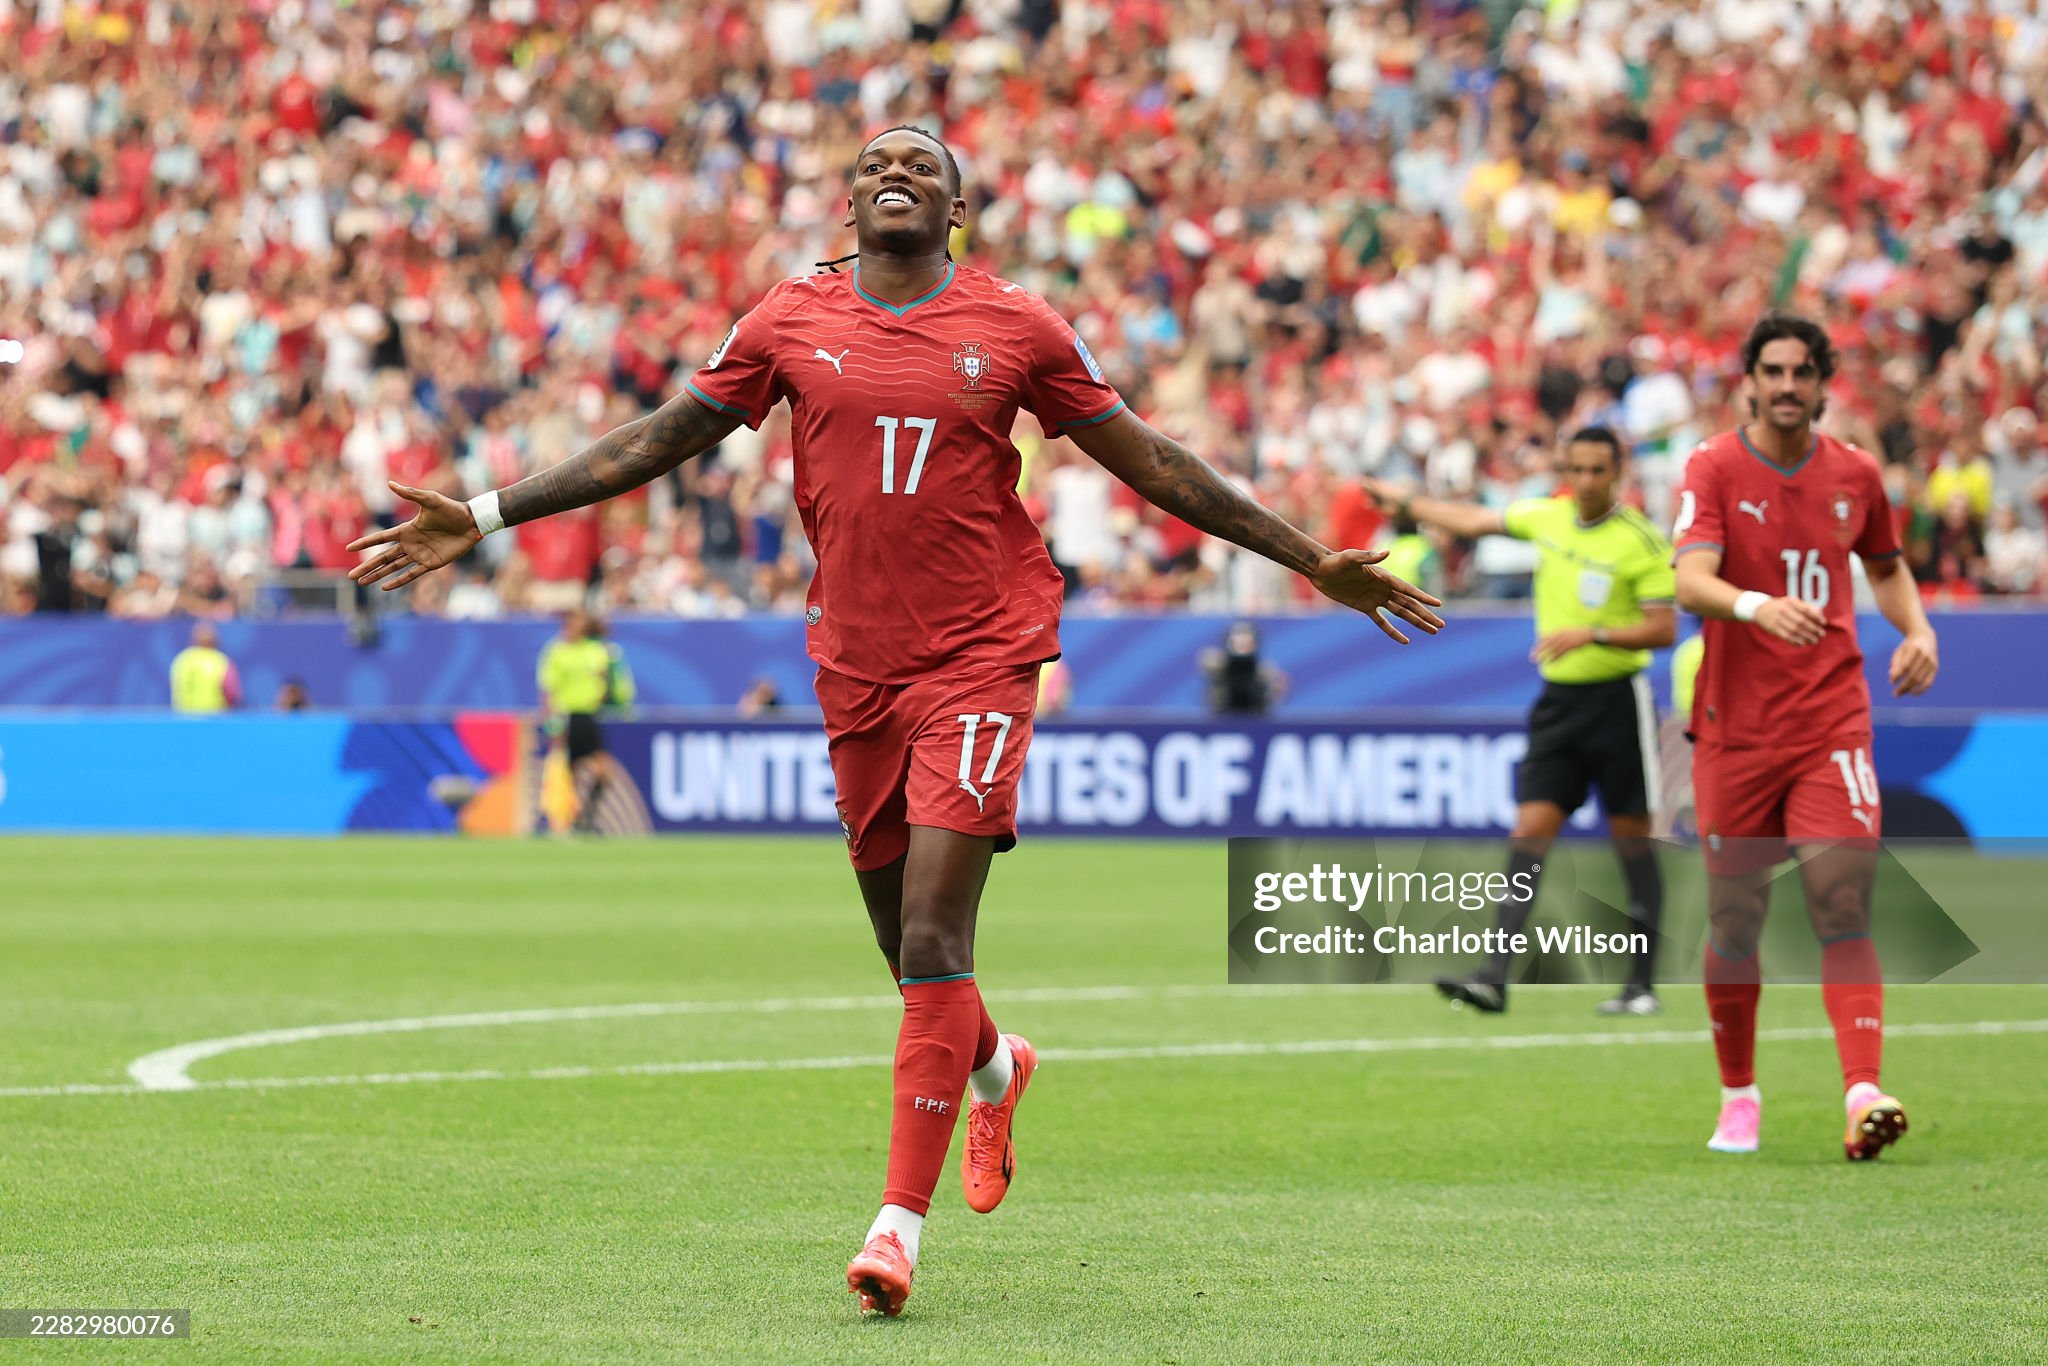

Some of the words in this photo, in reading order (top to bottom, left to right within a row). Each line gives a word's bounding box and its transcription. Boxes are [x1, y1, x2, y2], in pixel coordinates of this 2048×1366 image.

[874, 415, 937, 495] 17
[1780, 549, 1830, 609] 16
[652, 732, 839, 823] UNITE
[1015, 732, 1150, 826] TES
[1153, 732, 1251, 827] OF
[1254, 733, 1598, 829] AMERIC
[957, 712, 1013, 783] 17
[1830, 748, 1880, 808] 16
